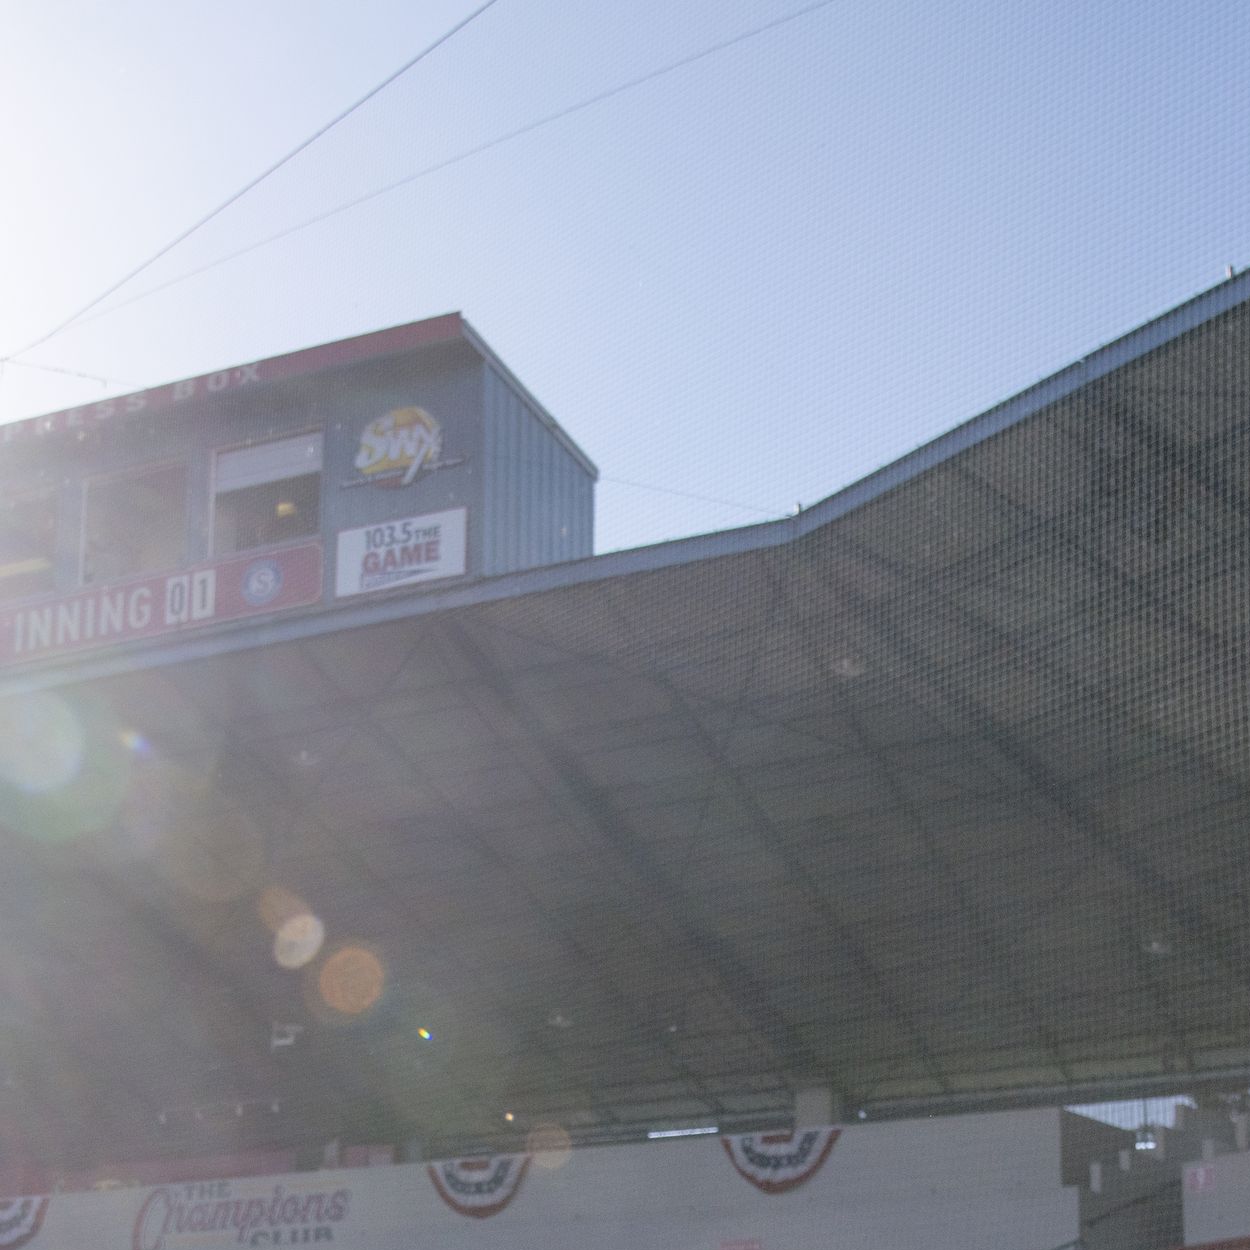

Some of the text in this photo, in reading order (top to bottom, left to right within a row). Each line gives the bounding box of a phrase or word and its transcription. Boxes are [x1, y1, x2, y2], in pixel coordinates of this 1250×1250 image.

[2, 362, 261, 444] PRESS BOX
[364, 521, 442, 550] 103.5 THE
[362, 539, 441, 573] GAME
[14, 587, 153, 655] INNING
[183, 1182, 232, 1200] THE
[249, 1226, 334, 1247] CLUB
